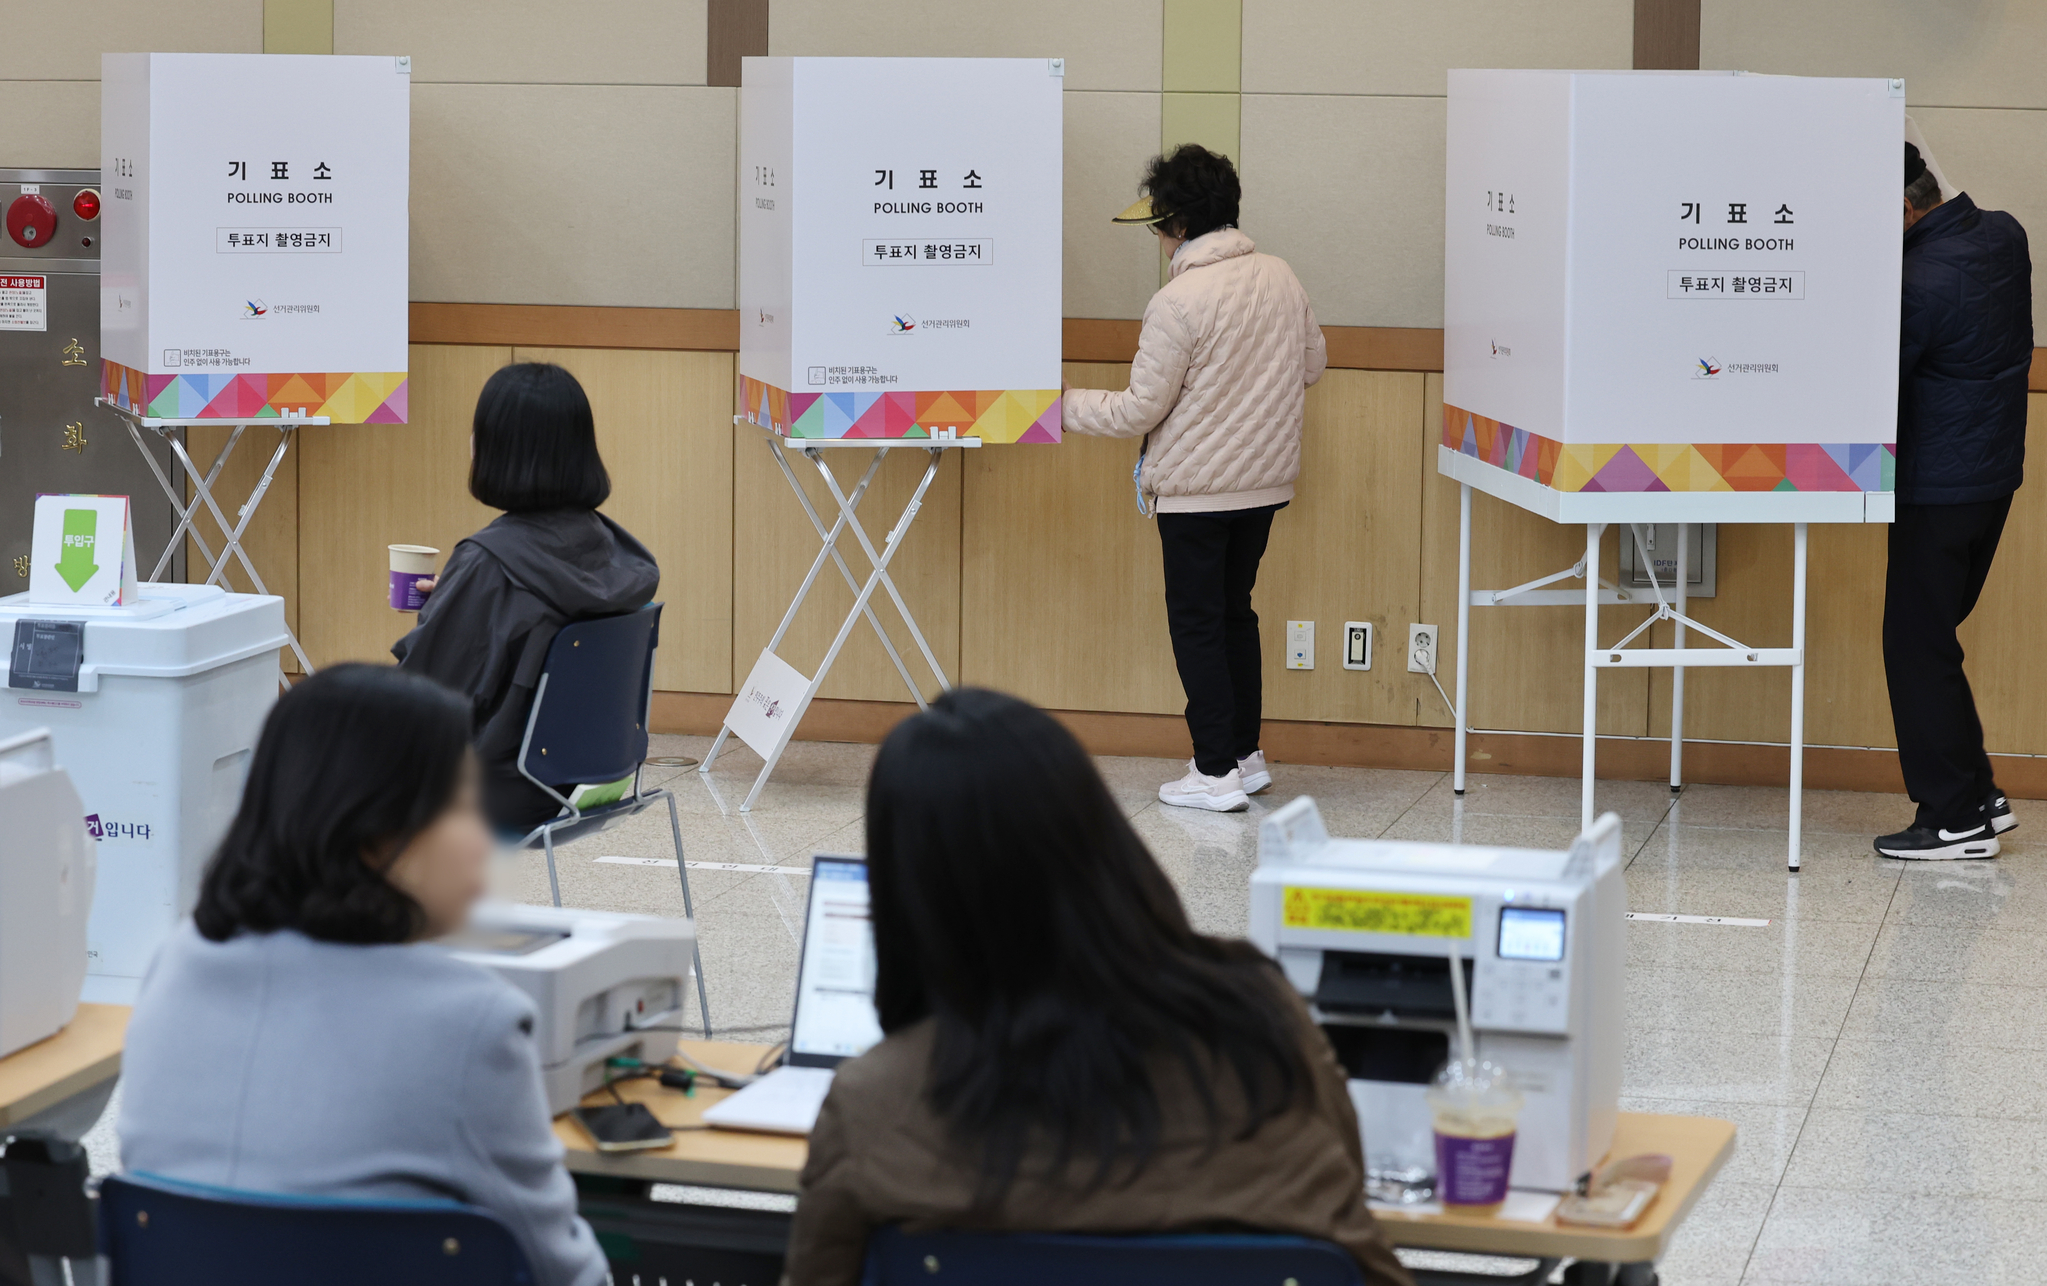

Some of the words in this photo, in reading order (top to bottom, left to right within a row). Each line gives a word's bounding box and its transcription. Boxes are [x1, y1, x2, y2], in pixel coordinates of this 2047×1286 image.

[227, 192, 283, 204] POLLING
[288, 192, 333, 204] BOOTH
[874, 202, 932, 214] POLLING
[936, 202, 984, 214] BOOTH
[1486, 223, 1502, 238] POLLING
[1502, 225, 1515, 240] BOOTH
[227, 232, 269, 248] 투표지
[275, 232, 331, 248] 촬영금지
[1679, 237, 1740, 250] POLLING
[1745, 238, 1794, 251] BOOTH
[874, 244, 917, 260] 투표지
[923, 243, 981, 260] 촬영금지
[10, 278, 41, 288] 사용방법
[1679, 276, 1725, 293] 투표지
[1731, 276, 1792, 293] 촬영금지
[273, 304, 320, 314] 선거관리위원회
[921, 319, 970, 329] 선거관리위원회
[183, 349, 201, 357] 비치된
[202, 349, 231, 357] 기표용구는
[183, 358, 195, 367] 인주
[196, 358, 208, 367] 없이
[209, 358, 221, 367] 사용
[222, 358, 251, 366] 가능합니다
[1727, 363, 1779, 373] 선거관리위원회
[828, 366, 847, 375] 비치된
[848, 366, 878, 375] 기표용구는
[828, 375, 841, 384] 인주
[841, 375, 854, 384] 없이
[855, 375, 867, 384] 사용
[868, 375, 898, 384] 가능합니다
[63, 534, 95, 548] 투입구
